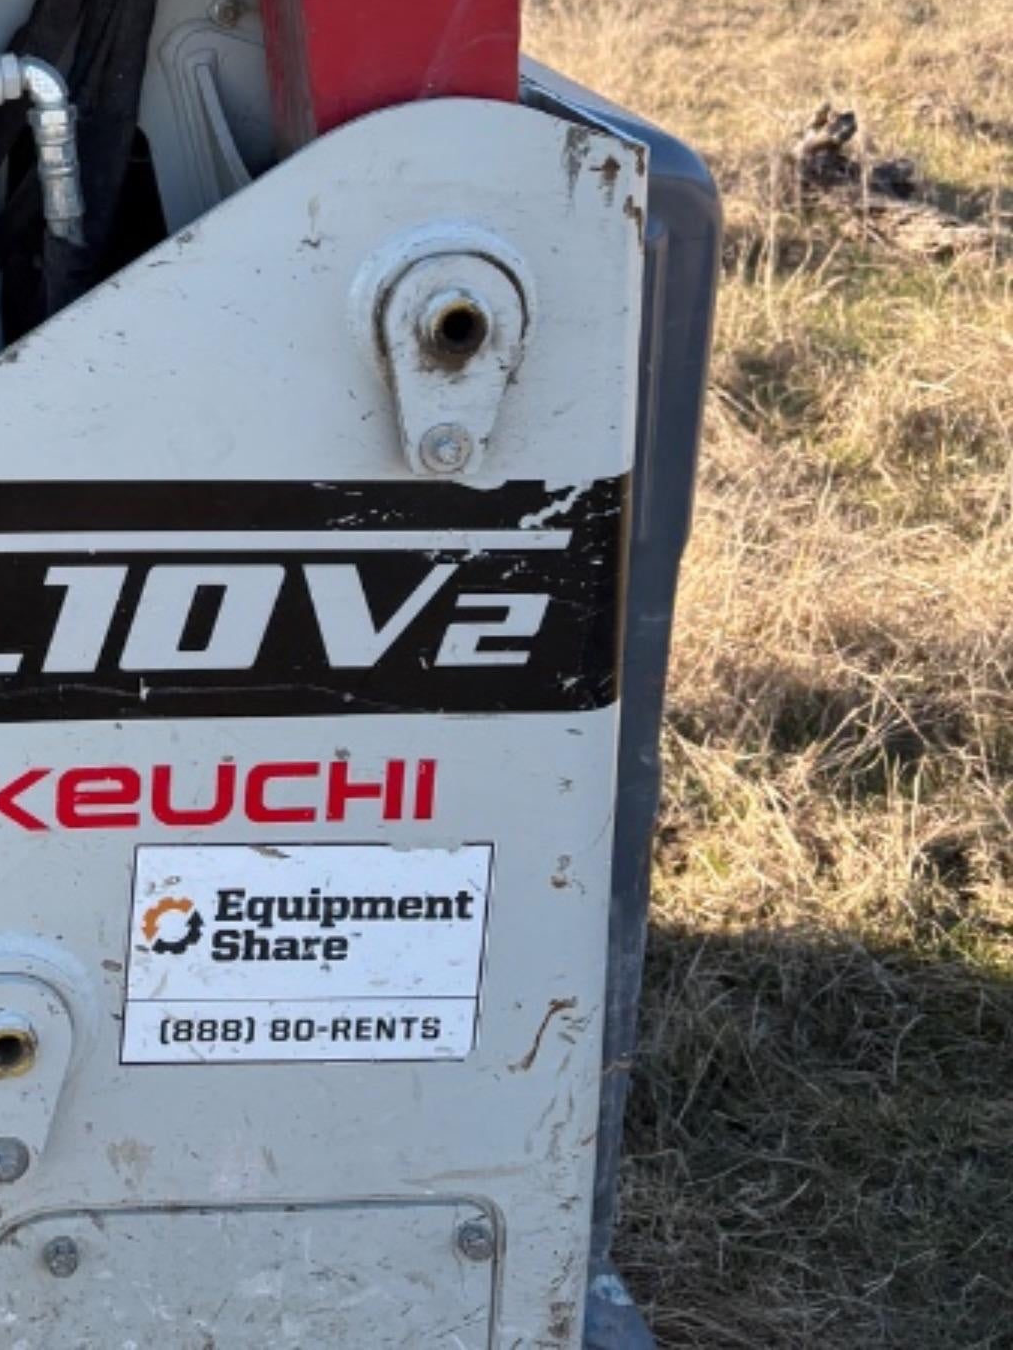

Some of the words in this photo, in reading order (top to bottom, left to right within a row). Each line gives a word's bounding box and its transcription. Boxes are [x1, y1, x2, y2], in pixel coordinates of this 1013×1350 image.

[214, 888, 474, 927] Equipment
[211, 929, 349, 962] Share
[159, 1016, 256, 1044] (888)
[269, 1016, 442, 1042] 80-RENTS
